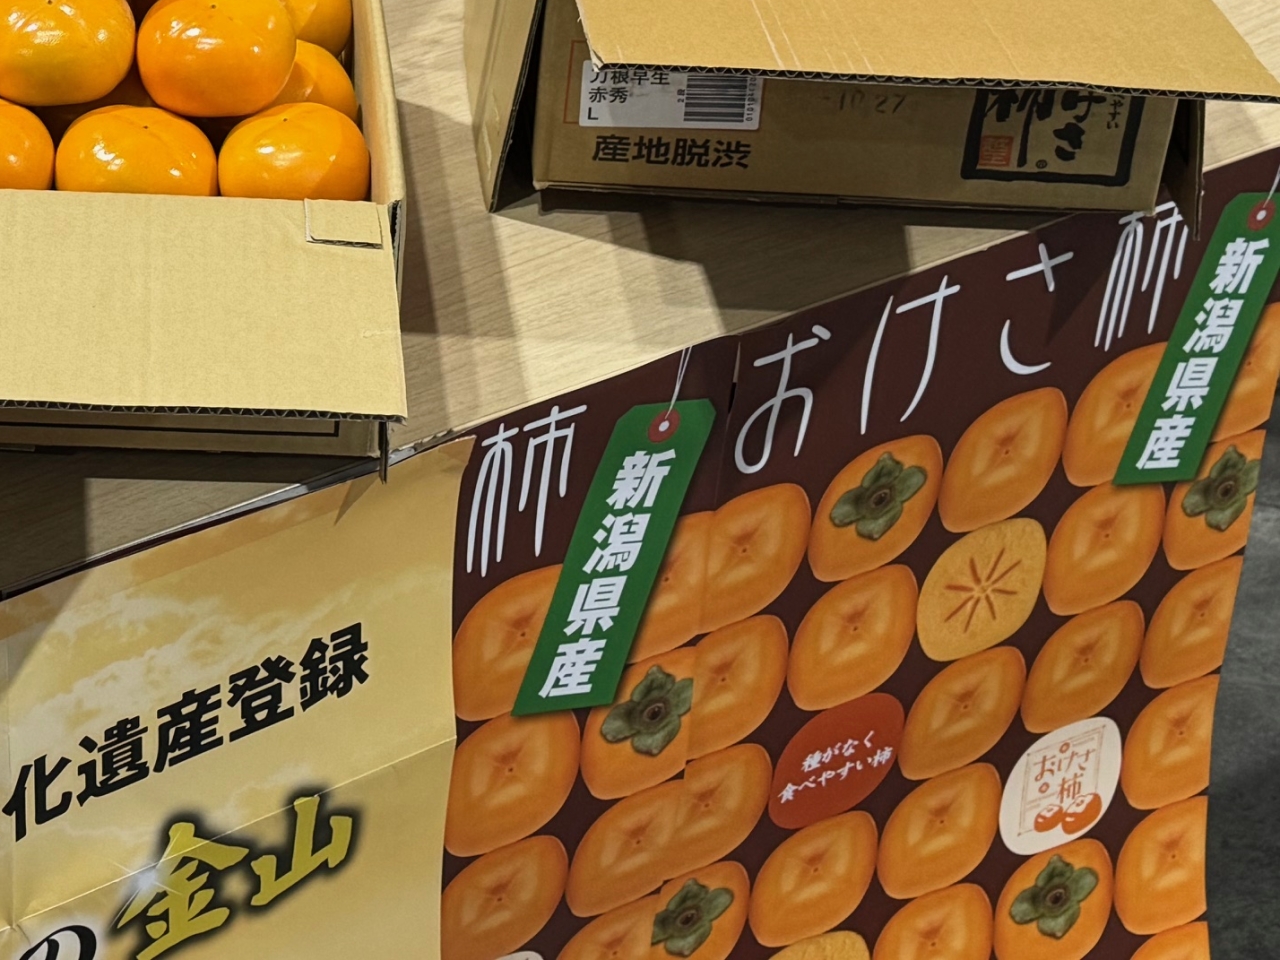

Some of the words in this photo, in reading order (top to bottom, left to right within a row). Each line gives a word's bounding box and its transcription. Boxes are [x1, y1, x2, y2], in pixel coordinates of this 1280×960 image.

[586, 107, 599, 121] L
[588, 87, 629, 104] 赤秀
[591, 134, 752, 169] 産地脱渋
[734, 198, 1190, 474] おけさ柿
[1135, 237, 1271, 471] 新潟県産
[537, 445, 677, 701] 新潟県産
[778, 745, 894, 804] 食べやすい柿
[801, 730, 876, 774] 種がなく
